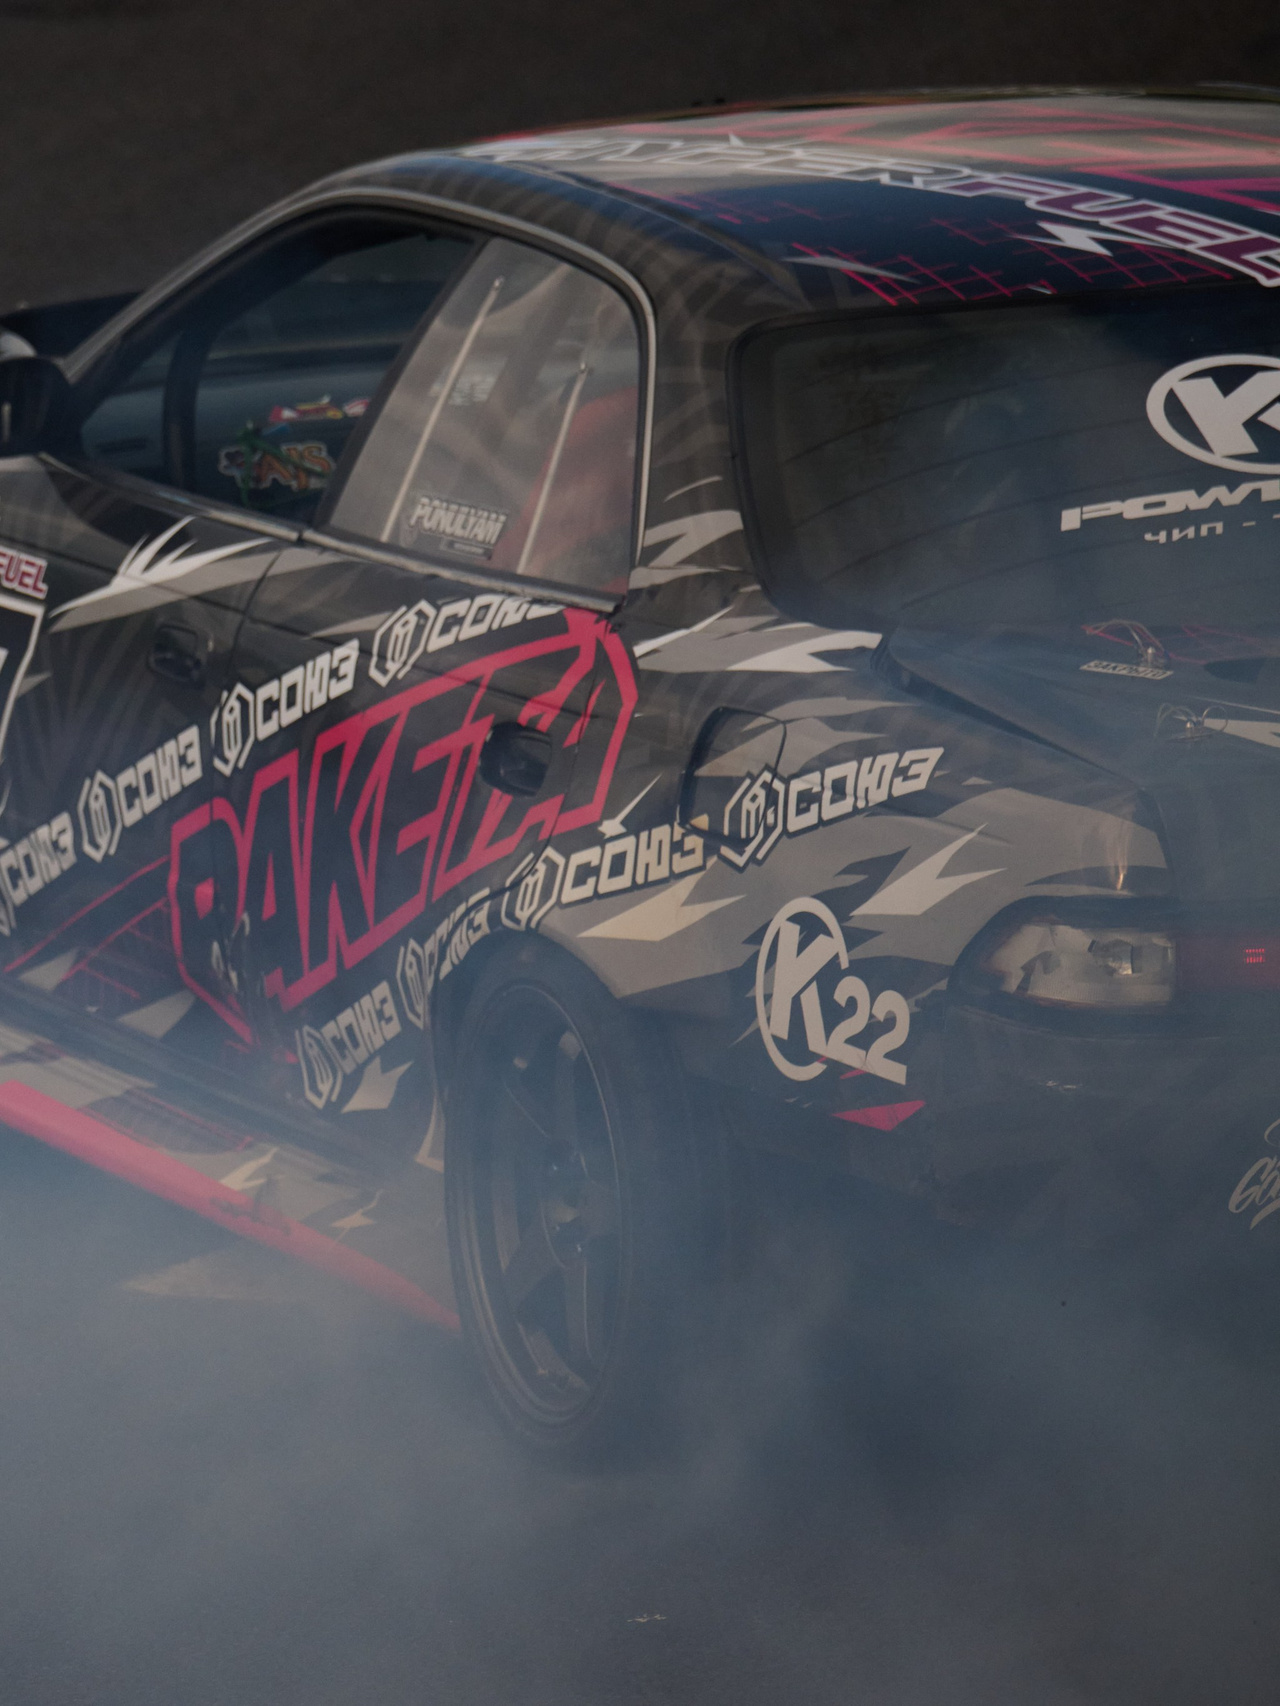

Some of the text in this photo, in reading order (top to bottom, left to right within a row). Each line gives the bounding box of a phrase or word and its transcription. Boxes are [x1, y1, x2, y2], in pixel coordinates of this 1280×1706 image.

[1060, 479, 1280, 532] POW
[1144, 521, 1223, 544] ЧИП
[787, 747, 945, 834] СОЮЗ
[763, 908, 910, 1085] K22
